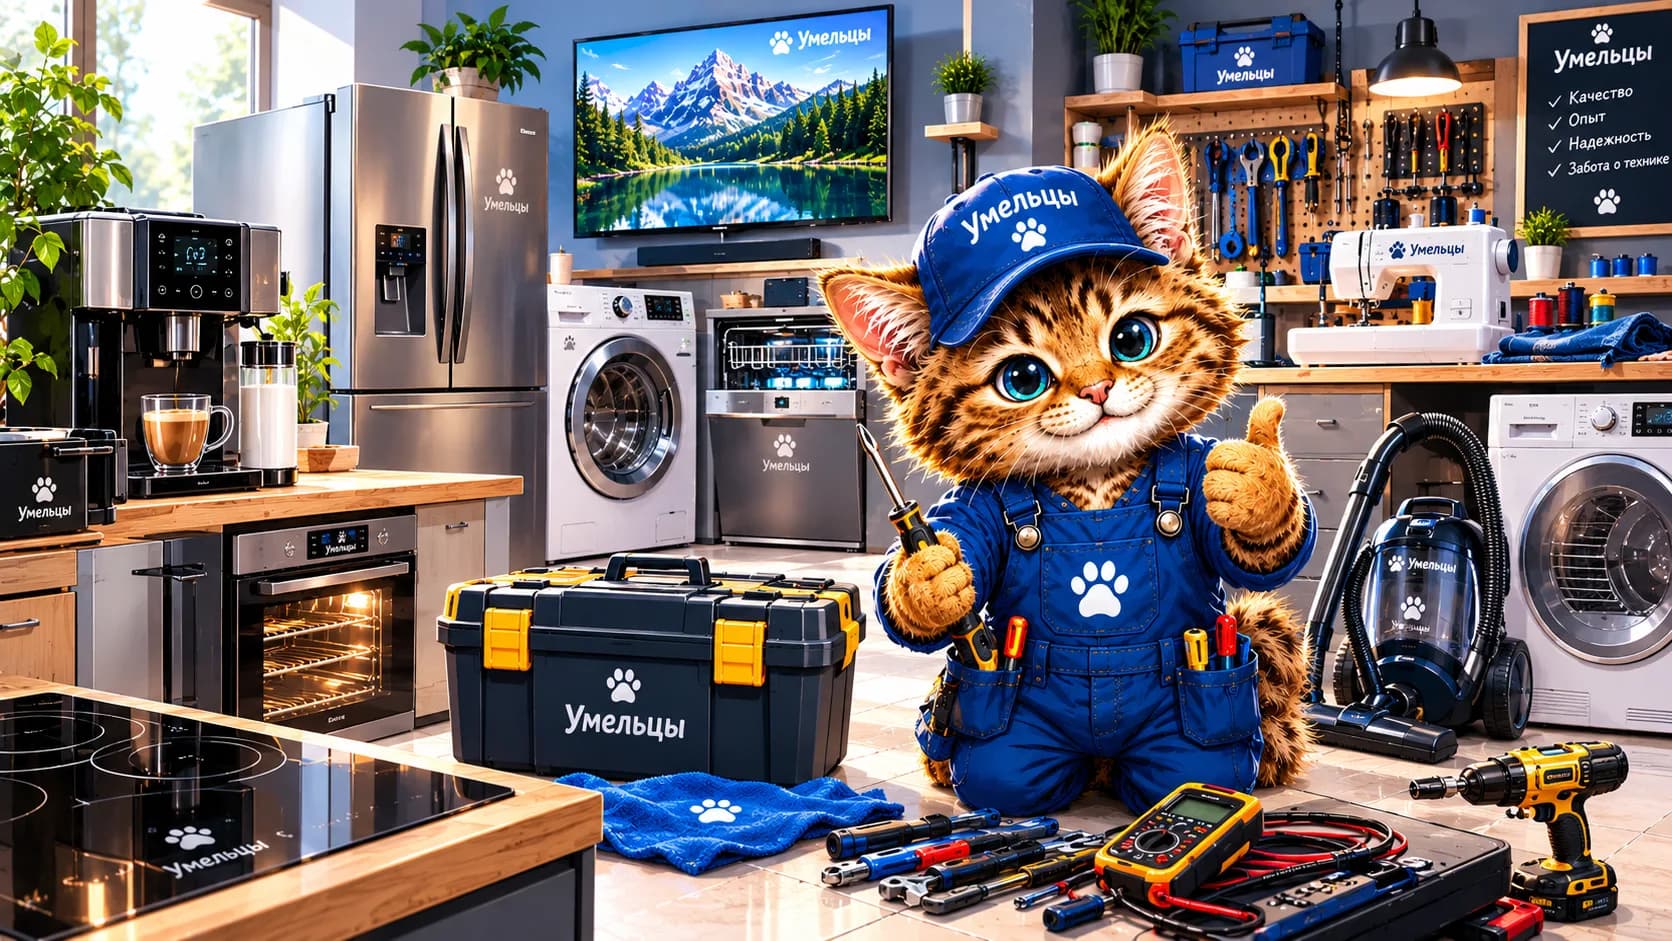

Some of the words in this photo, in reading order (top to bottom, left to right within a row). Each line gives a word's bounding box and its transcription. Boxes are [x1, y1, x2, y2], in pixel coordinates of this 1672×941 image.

[798, 27, 871, 50] Умельцы
[1553, 45, 1653, 74] Умельцы
[1216, 68, 1275, 85] Умельцы
[1568, 87, 1633, 105] Качество
[1568, 112, 1606, 128] Опыт
[1568, 131, 1652, 151] Надежность
[1568, 160, 1610, 176] Забота
[1613, 160, 1621, 170] о
[1623, 154, 1670, 169] технике
[484, 196, 529, 214] Умельцы
[960, 188, 1079, 245] Умельцы
[1410, 243, 1464, 257] Умельцы
[762, 458, 810, 472] Умельцы
[18, 505, 72, 522] Умельцы
[1408, 557, 1457, 574] Умельцы
[564, 703, 685, 742] Умельцы
[161, 839, 270, 880] Умельцы
